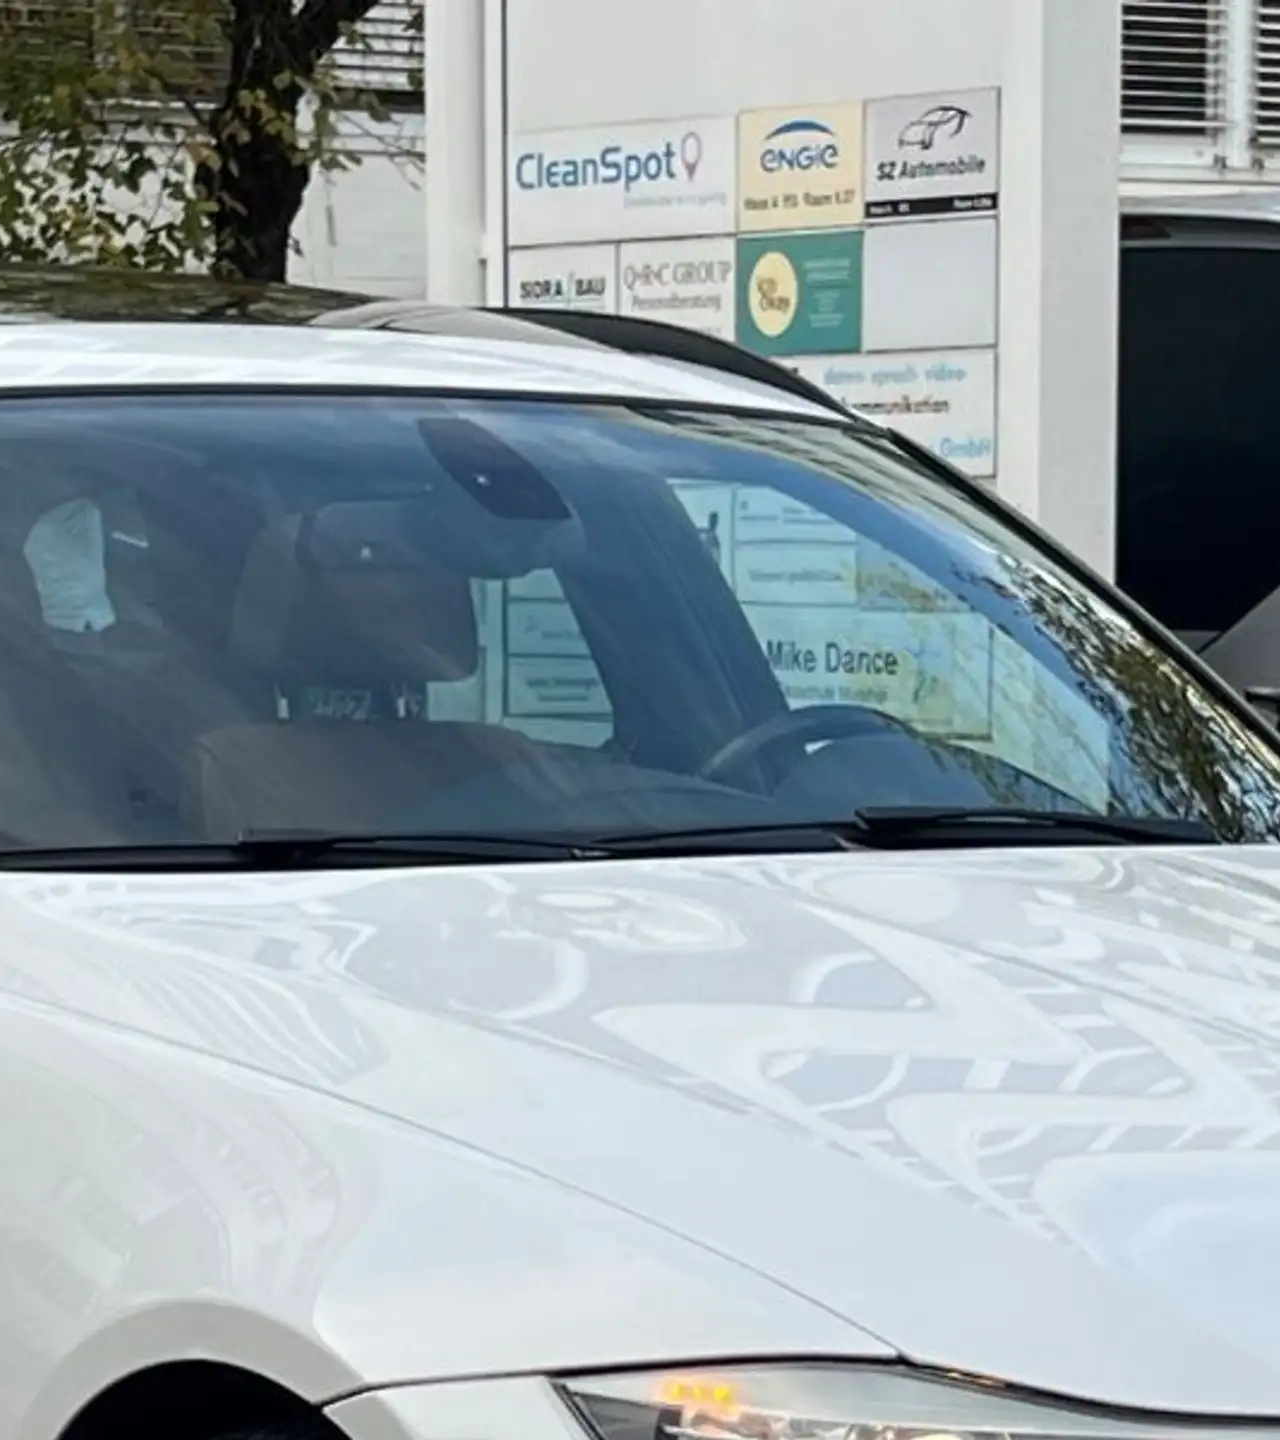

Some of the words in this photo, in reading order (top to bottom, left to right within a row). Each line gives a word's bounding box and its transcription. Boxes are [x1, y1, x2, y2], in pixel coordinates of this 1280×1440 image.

[516, 141, 676, 192] CleanSpot
[876, 161, 895, 181] SZ
[898, 155, 986, 178] Automobile
[673, 260, 733, 285] GROUP
[767, 640, 816, 673] Mike
[825, 642, 898, 676] Dance
